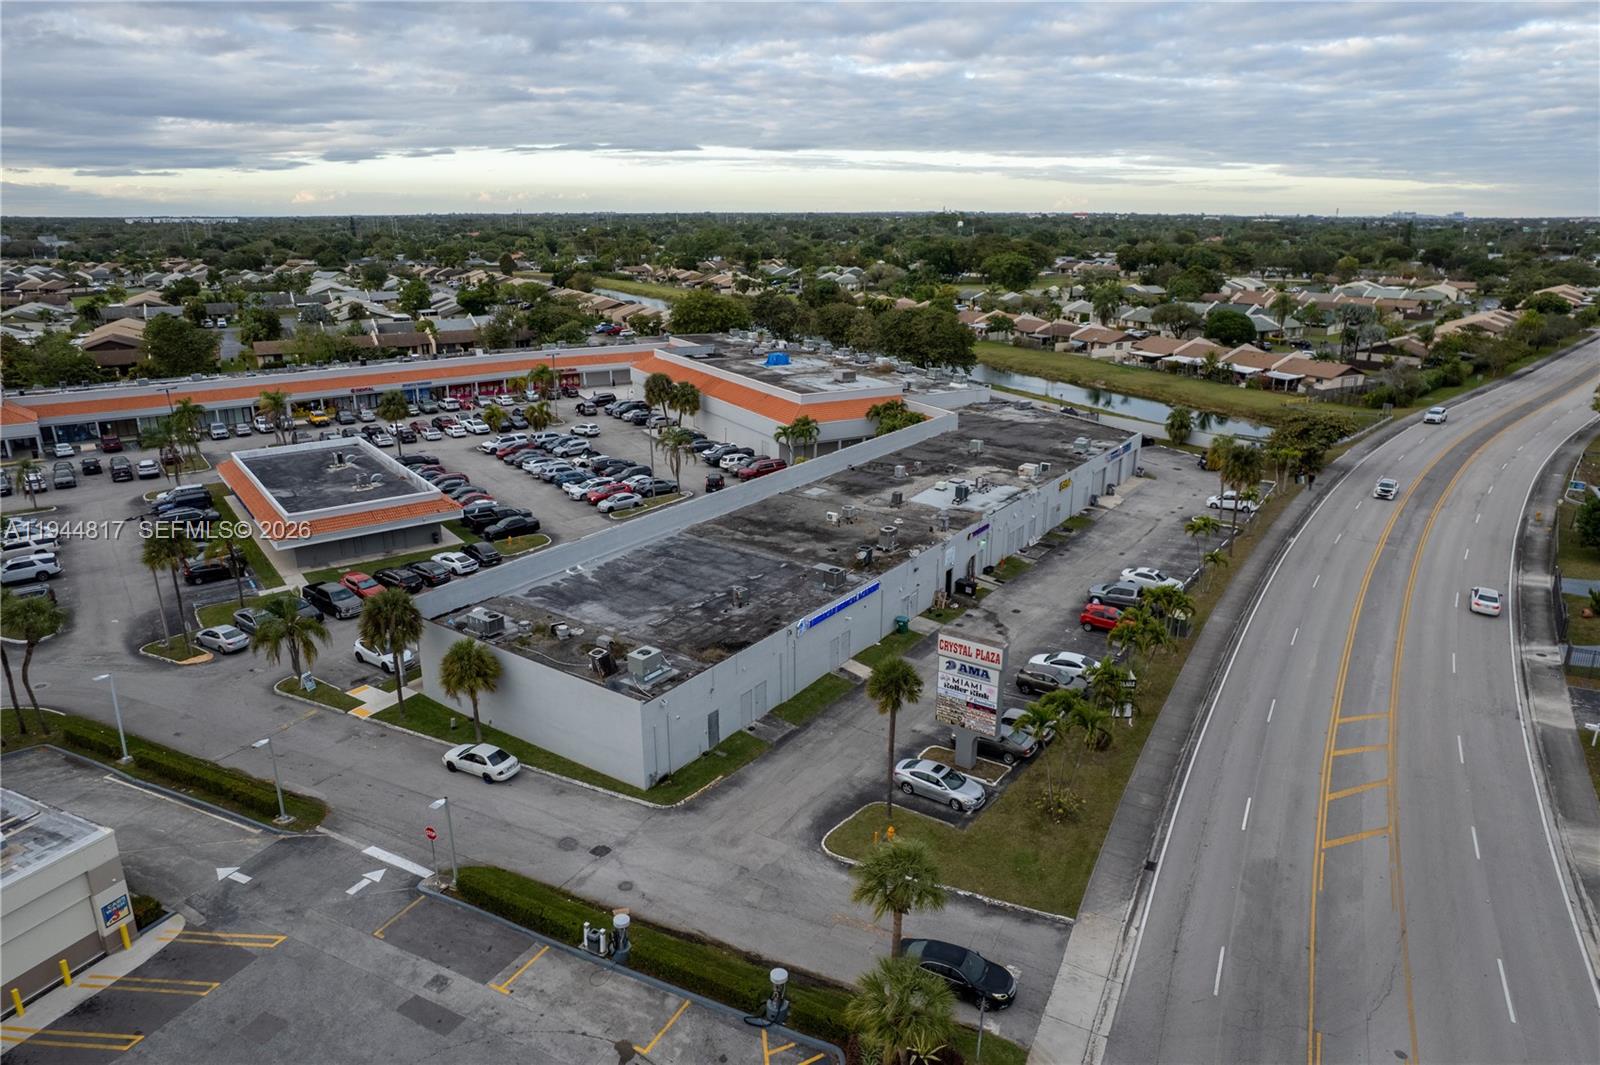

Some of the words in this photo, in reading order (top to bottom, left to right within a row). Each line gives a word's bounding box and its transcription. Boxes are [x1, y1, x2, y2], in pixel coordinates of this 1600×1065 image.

[939, 639, 973, 658] CRYSTAL
[975, 648, 1001, 665] PLAZA
[959, 663, 991, 679] AMA
[944, 682, 969, 694] Roller
[970, 688, 990, 700] Rink
[952, 677, 982, 691] MIAMI
